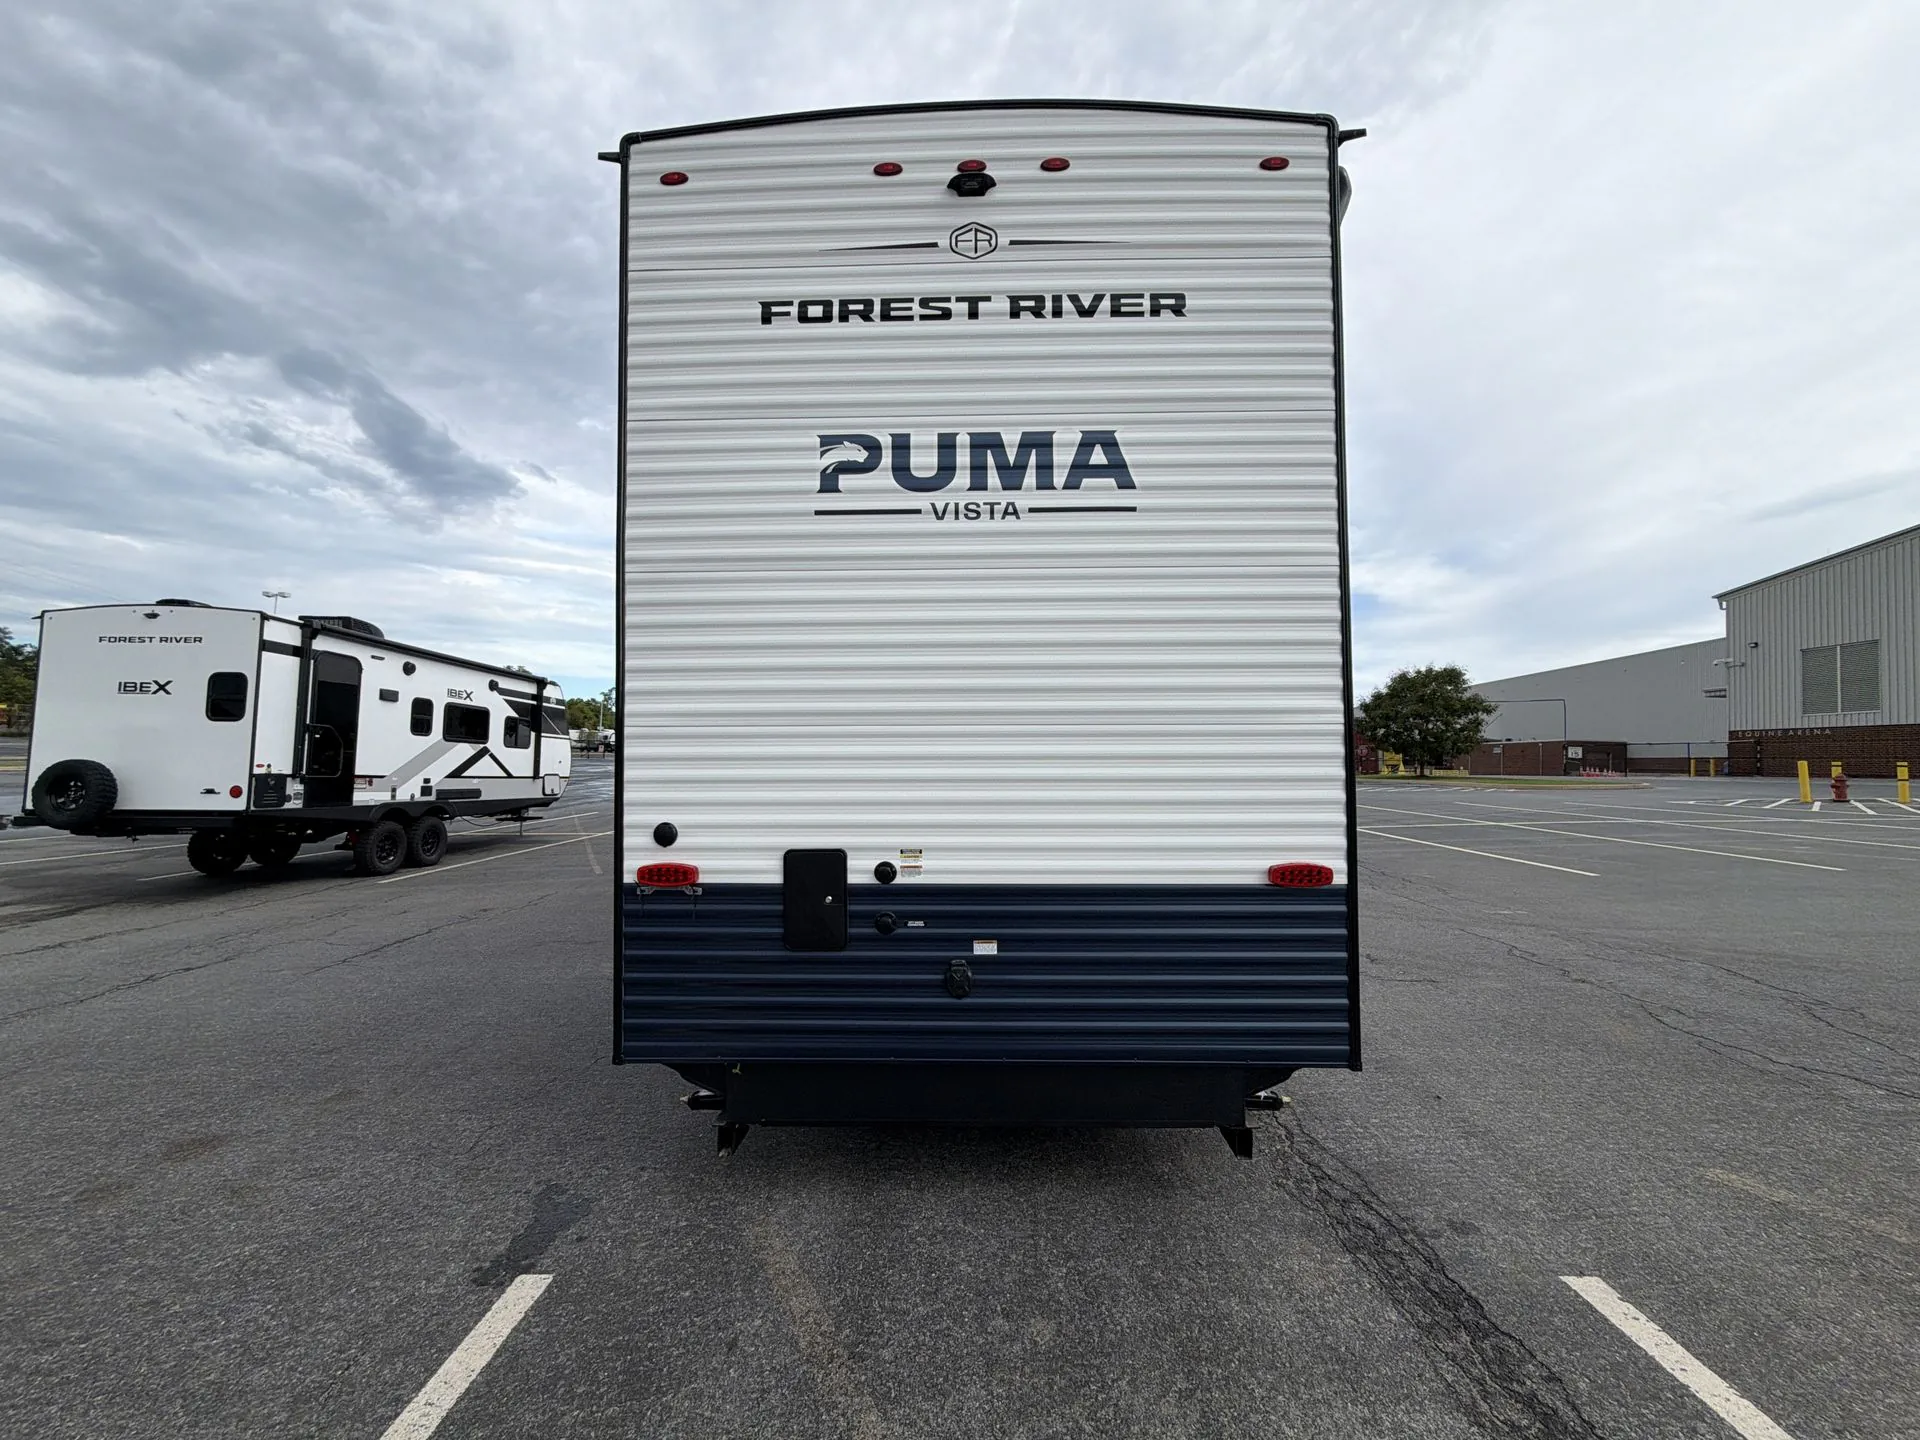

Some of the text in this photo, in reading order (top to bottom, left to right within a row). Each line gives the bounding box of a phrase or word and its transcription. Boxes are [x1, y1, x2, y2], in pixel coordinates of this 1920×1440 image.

[758, 292, 1187, 325] FOREST RIVER
[816, 430, 1137, 493] PUMA
[929, 501, 1021, 521] VISTA
[117, 680, 173, 695] IBEX
[447, 688, 474, 702] IBEX
[1738, 728, 1832, 738] EQUINE ARENA
